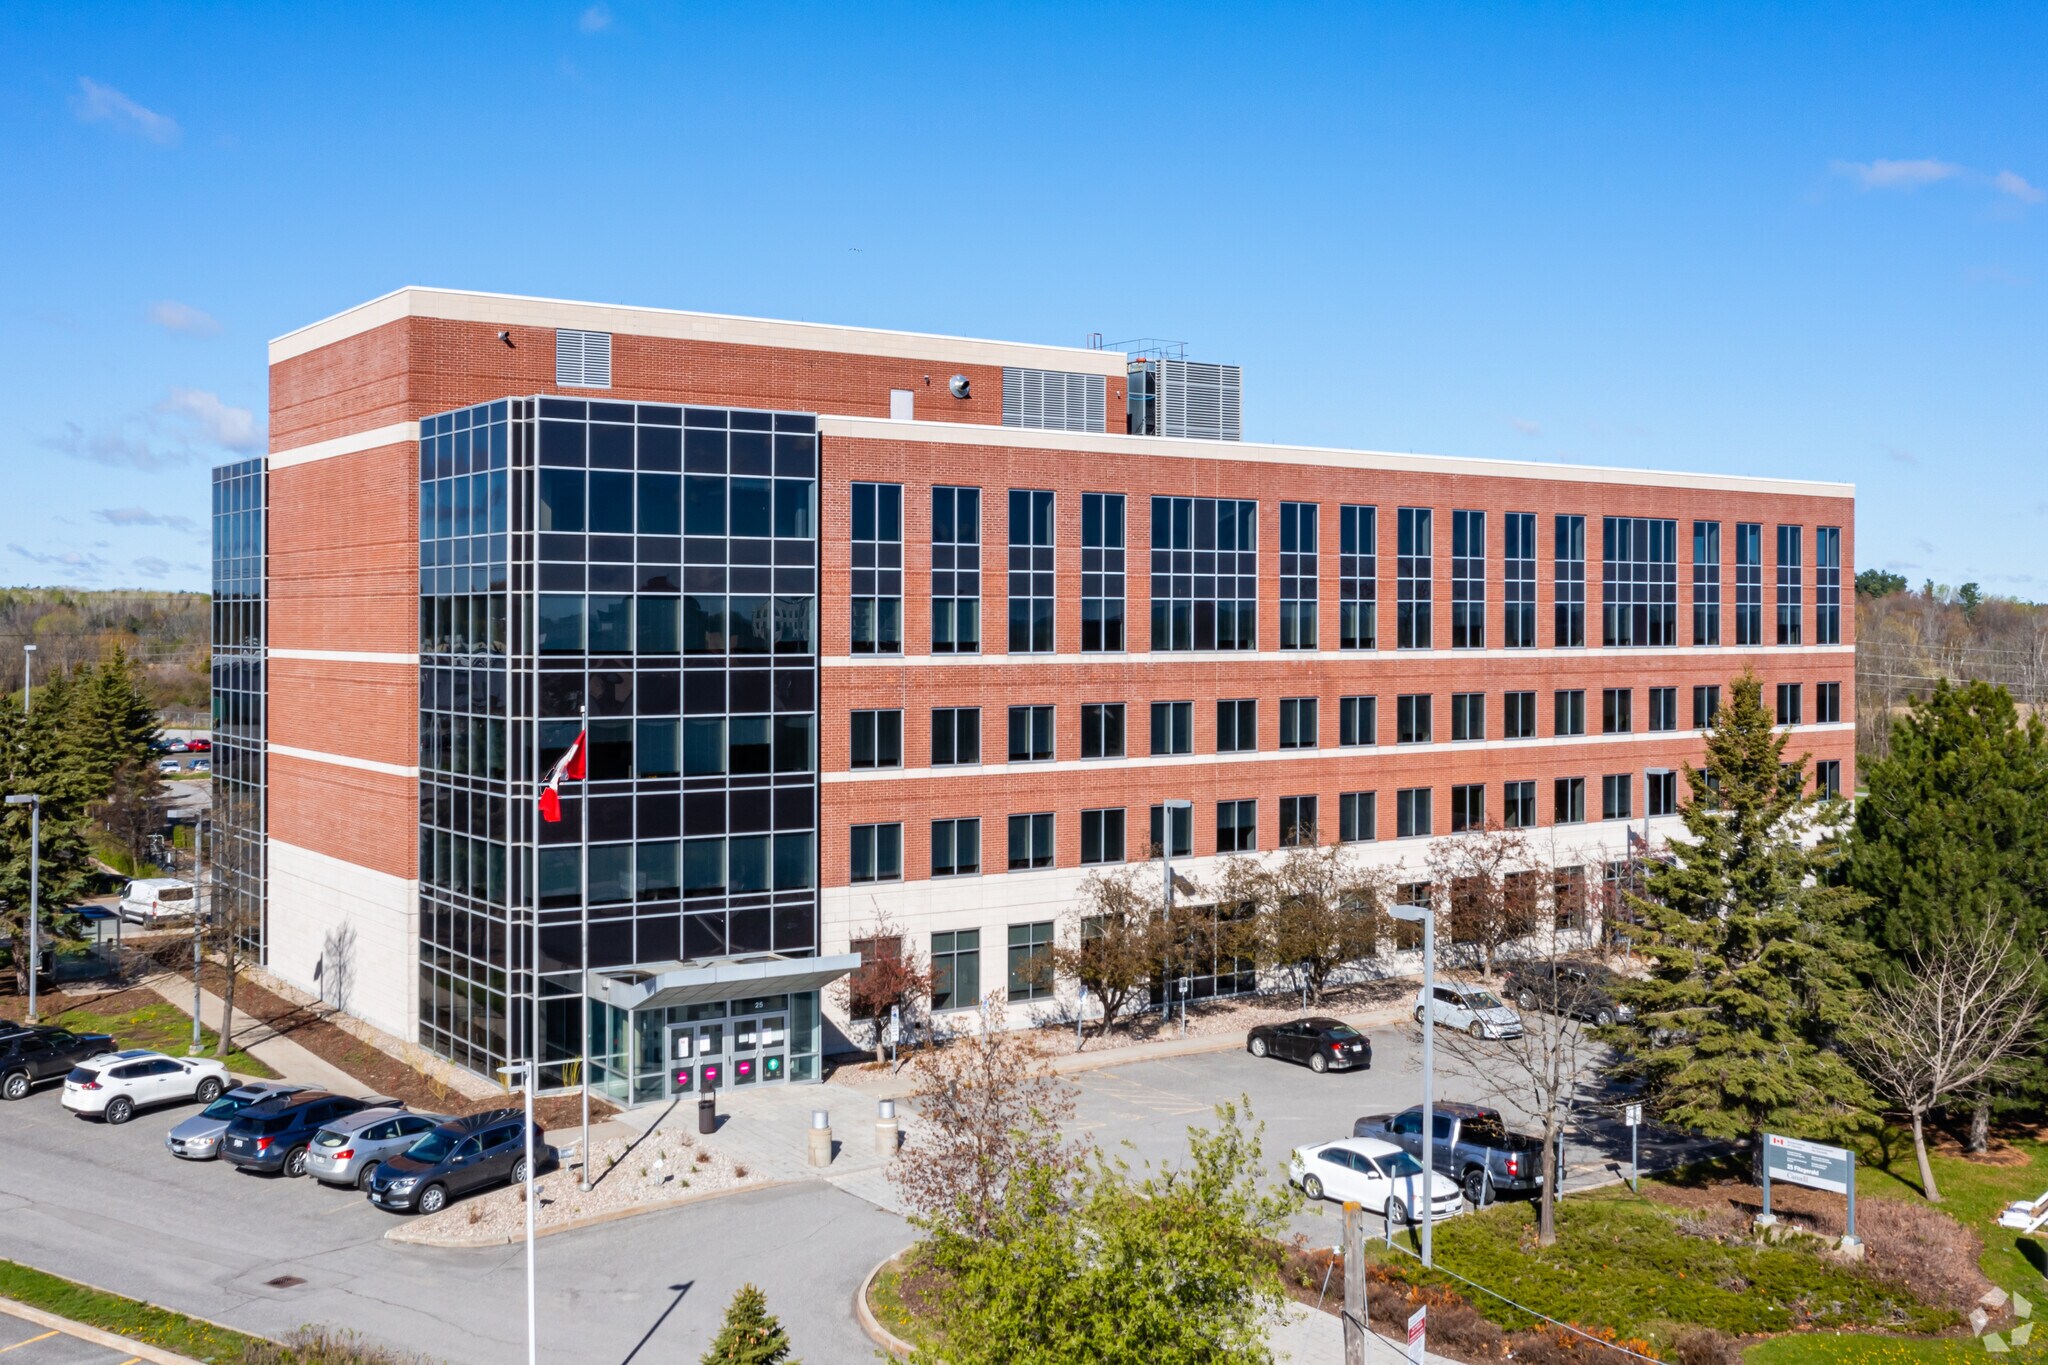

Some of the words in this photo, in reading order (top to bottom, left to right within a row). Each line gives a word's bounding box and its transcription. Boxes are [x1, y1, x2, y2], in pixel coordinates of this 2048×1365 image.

[755, 1001, 764, 1009] 25
[1786, 1163, 1794, 1171] 25
[1794, 1165, 1820, 1176] Fitzgerald
